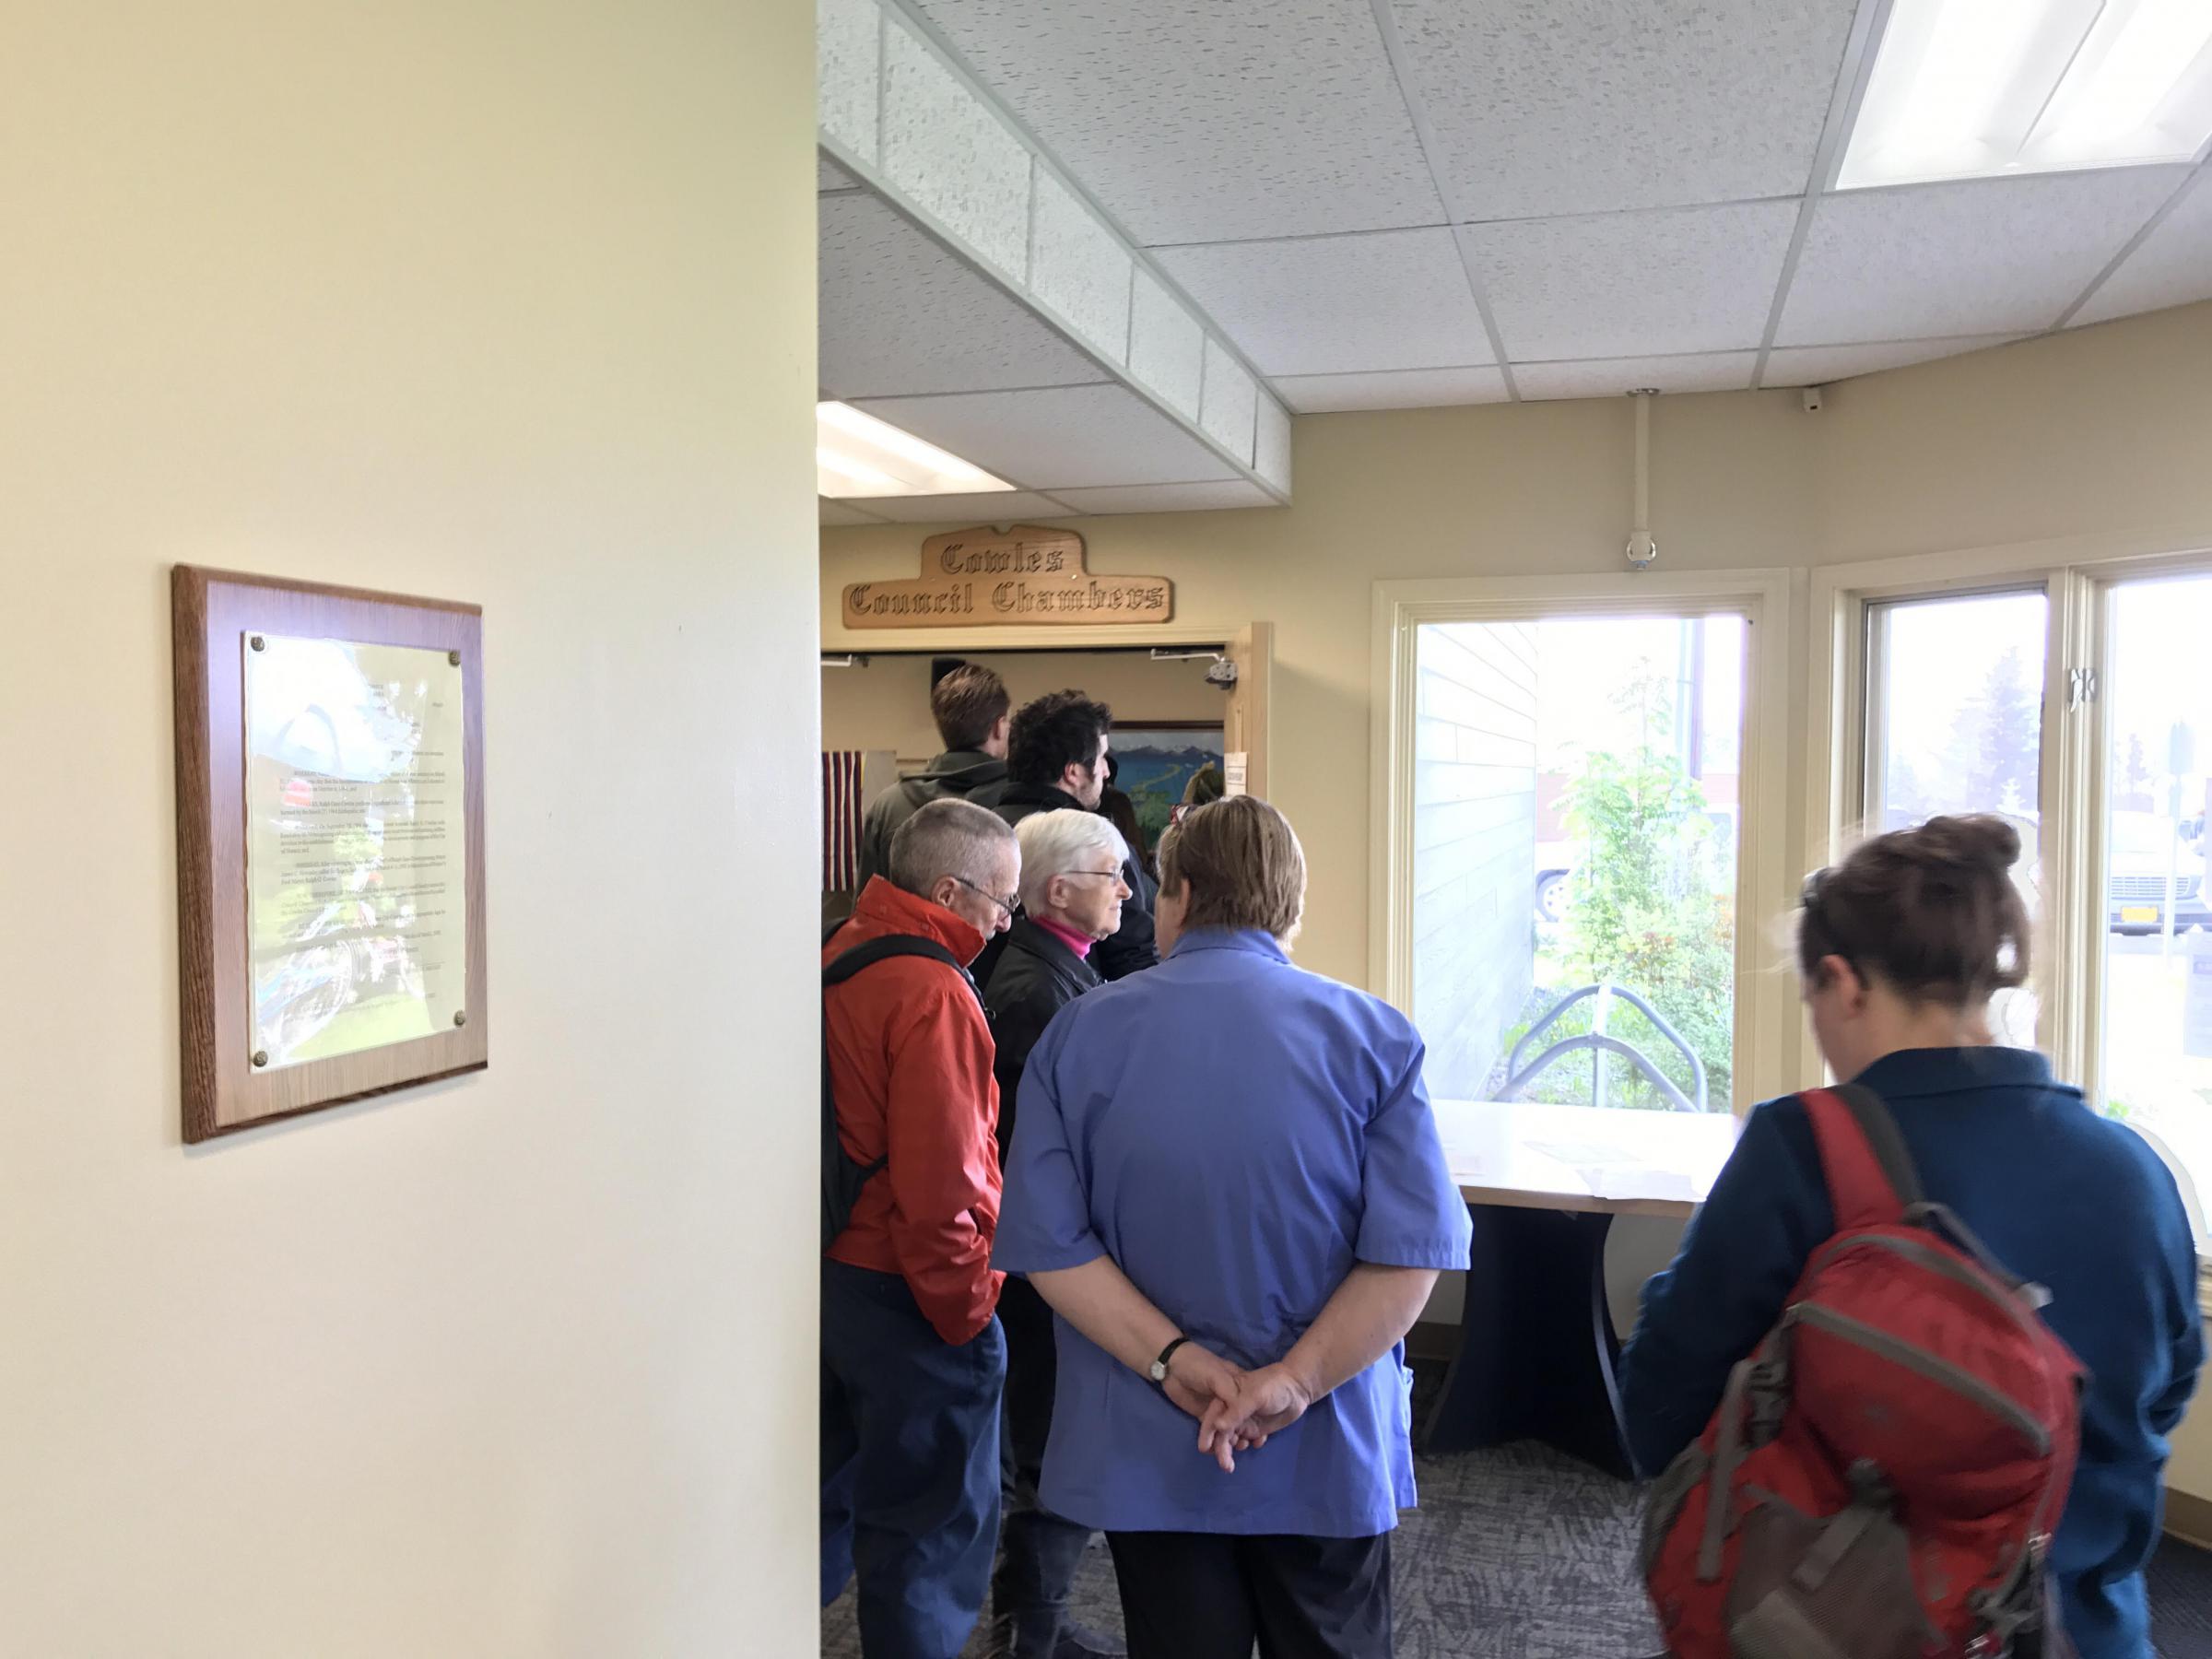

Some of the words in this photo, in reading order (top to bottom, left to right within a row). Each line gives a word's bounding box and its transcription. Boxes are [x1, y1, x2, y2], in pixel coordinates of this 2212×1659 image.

[940, 542, 1065, 575] Cowles
[849, 582, 974, 616] Council
[992, 581, 1164, 613] Chambers
